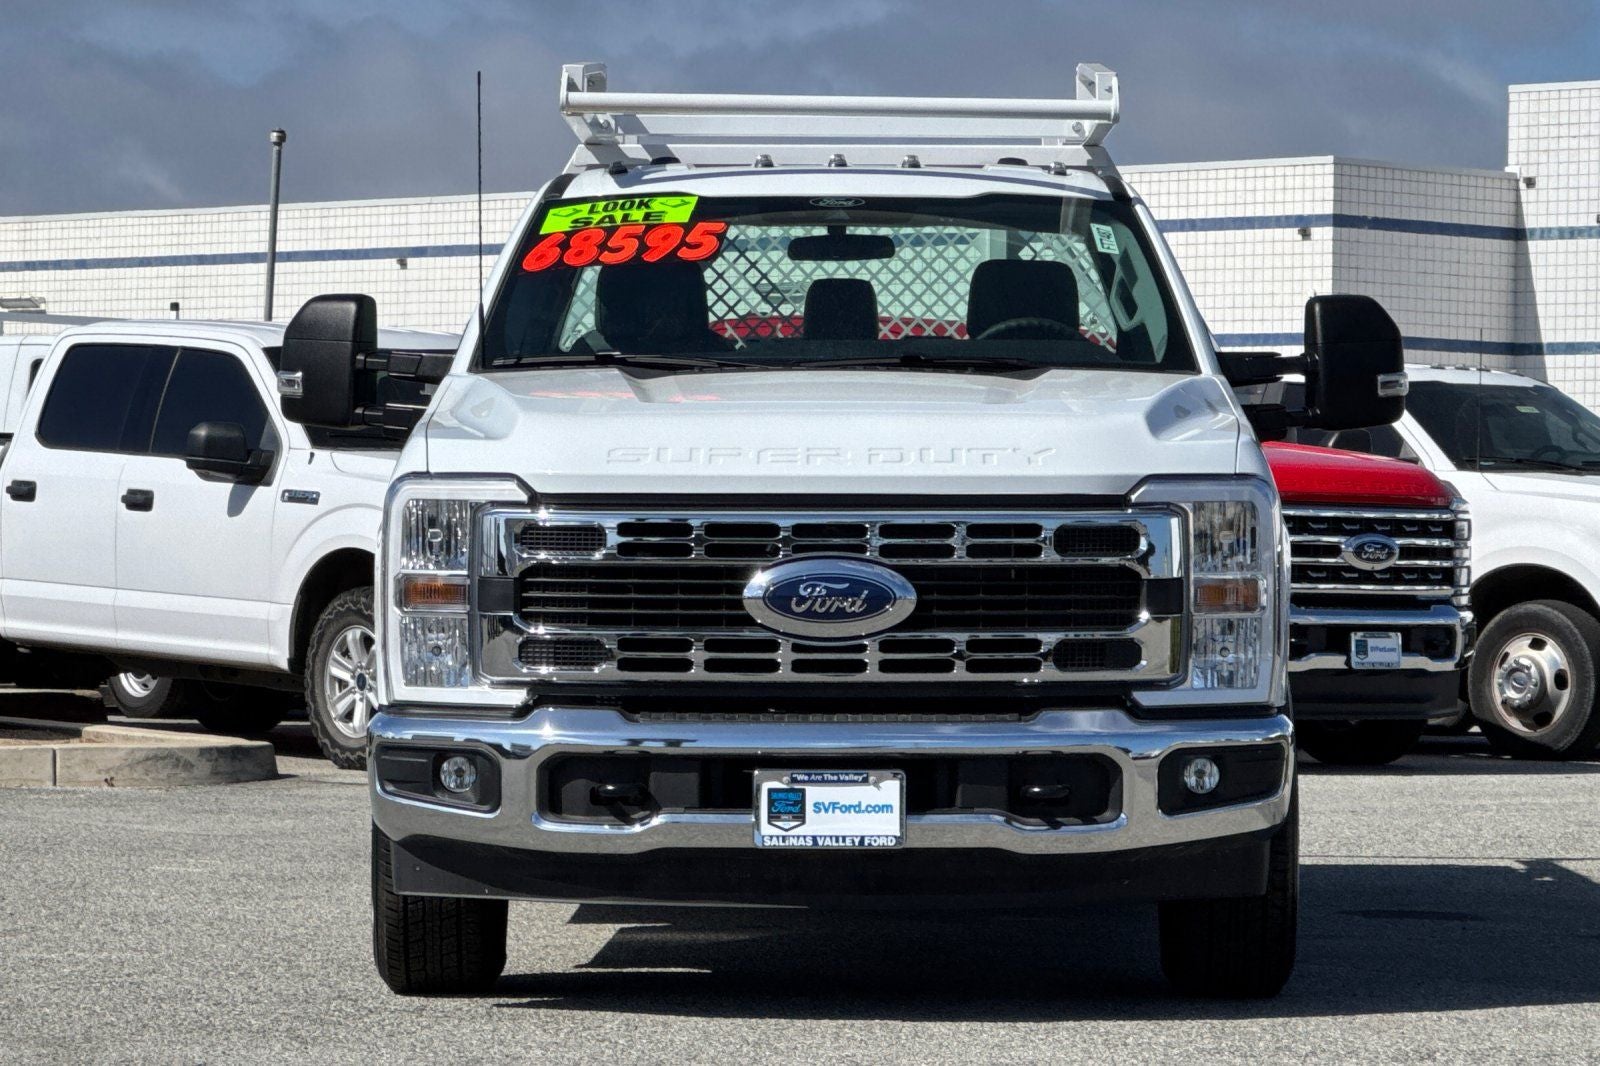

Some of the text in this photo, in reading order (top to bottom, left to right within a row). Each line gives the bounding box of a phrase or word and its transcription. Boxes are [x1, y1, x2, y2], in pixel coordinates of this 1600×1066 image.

[588, 198, 652, 215] LOOK
[568, 210, 667, 229] SALE
[522, 221, 728, 272] 68595
[606, 447, 1056, 465] SUPER DUTY
[1361, 543, 1389, 560] Ford
[790, 581, 869, 614] Ford
[809, 773, 823, 781] Are
[823, 773, 839, 781] The
[771, 800, 802, 813] Ford
[812, 801, 893, 814] SVFord.com
[763, 836, 896, 846] SALINAS VALLEY FORD
